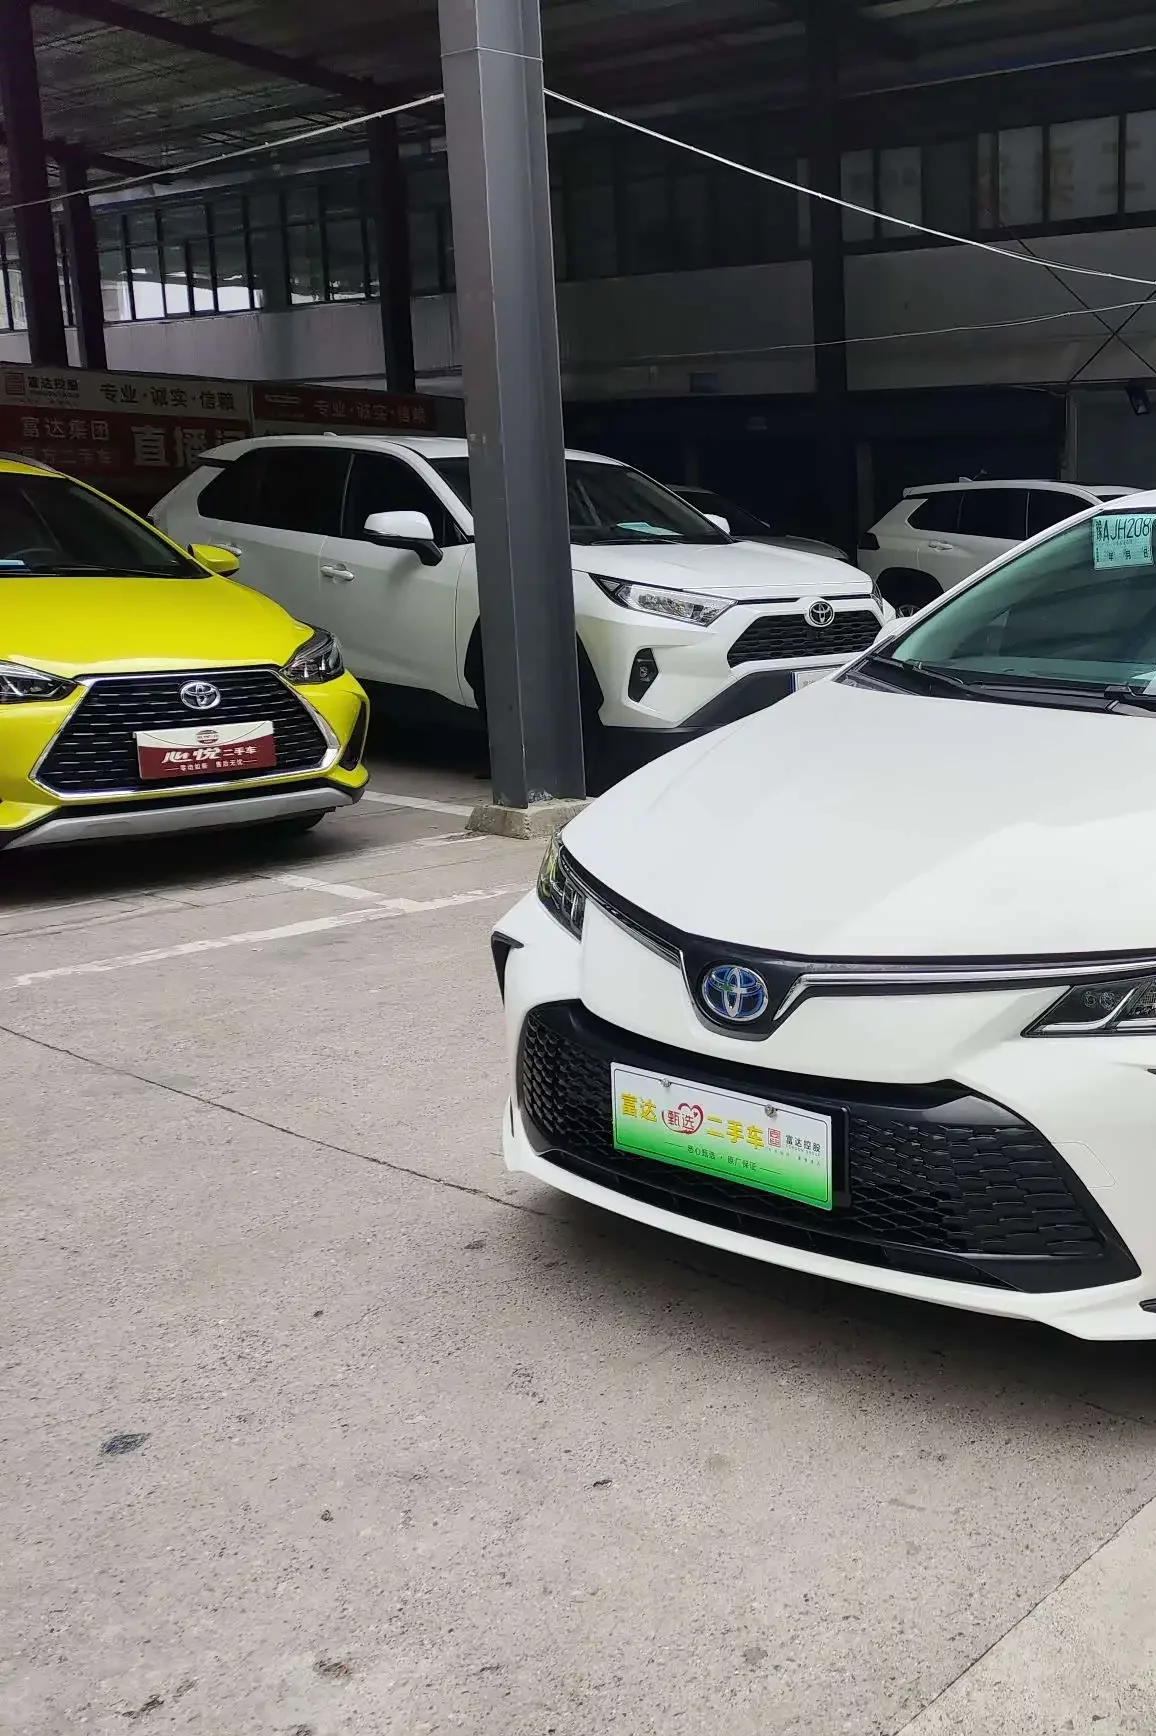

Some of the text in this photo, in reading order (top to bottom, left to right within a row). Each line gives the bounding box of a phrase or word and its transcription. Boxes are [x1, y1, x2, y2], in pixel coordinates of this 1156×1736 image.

[20, 416, 111, 441] 富达集团
[222, 746, 258, 757] 二手车
[620, 1091, 658, 1124] 富达
[667, 1109, 698, 1132] 甄选
[706, 1114, 765, 1150] 二手车
[785, 1134, 820, 1152] 富达控股
